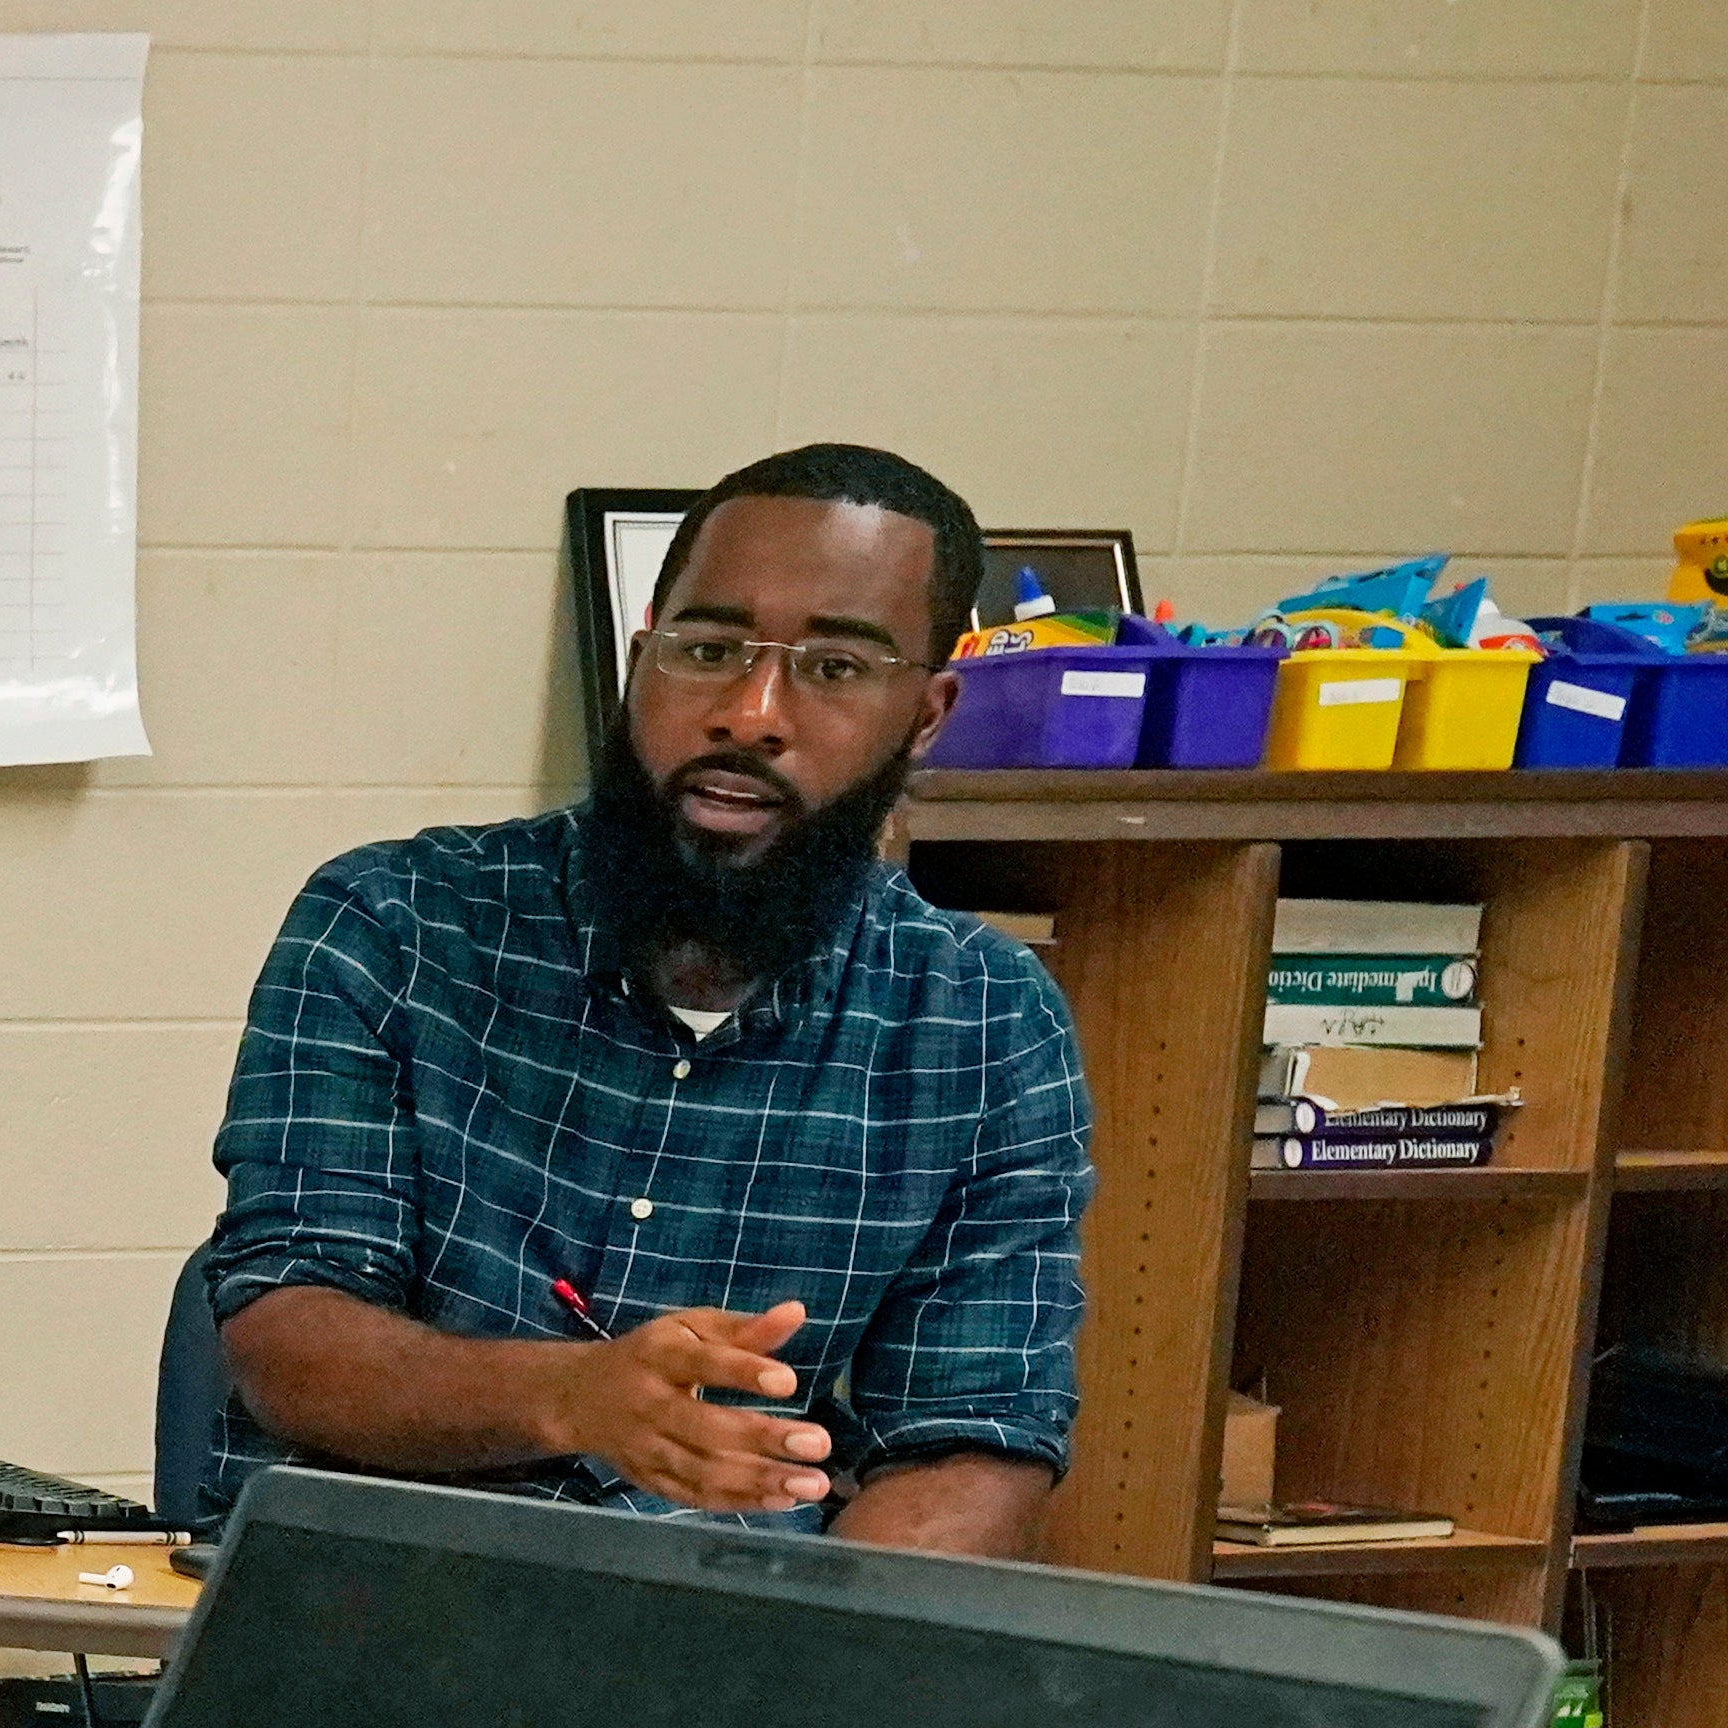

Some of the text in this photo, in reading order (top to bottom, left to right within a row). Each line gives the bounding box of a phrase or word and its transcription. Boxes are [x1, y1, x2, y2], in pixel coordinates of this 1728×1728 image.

[1411, 1107, 1488, 1133] Dictionary
[1311, 1139, 1480, 1165] Elementary Dictionary
